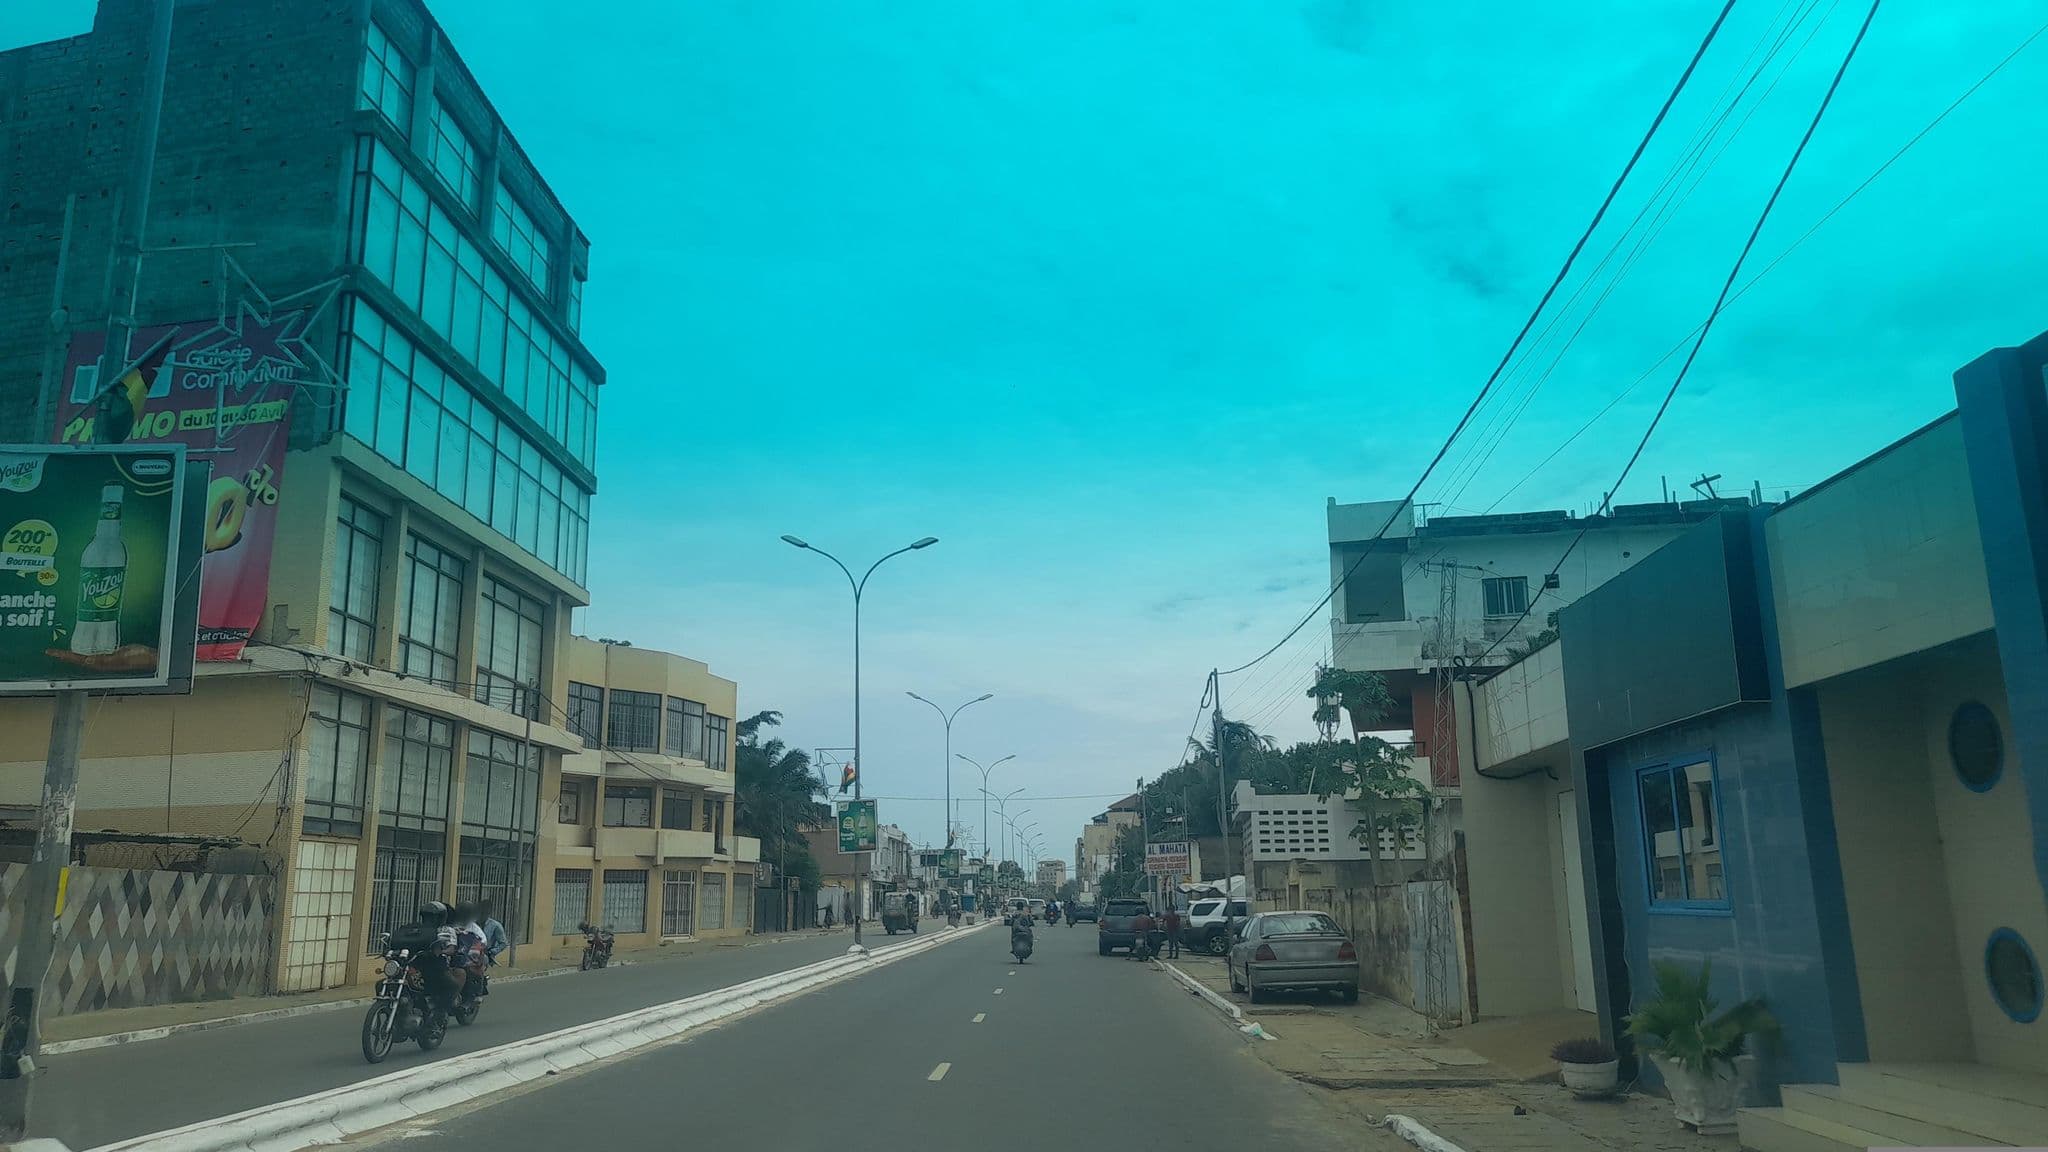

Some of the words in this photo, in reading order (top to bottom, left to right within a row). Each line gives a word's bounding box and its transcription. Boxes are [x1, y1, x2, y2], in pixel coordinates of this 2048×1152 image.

[183, 415, 203, 427] du
[8, 529, 46, 545] 200
[6, 608, 44, 627] soif
